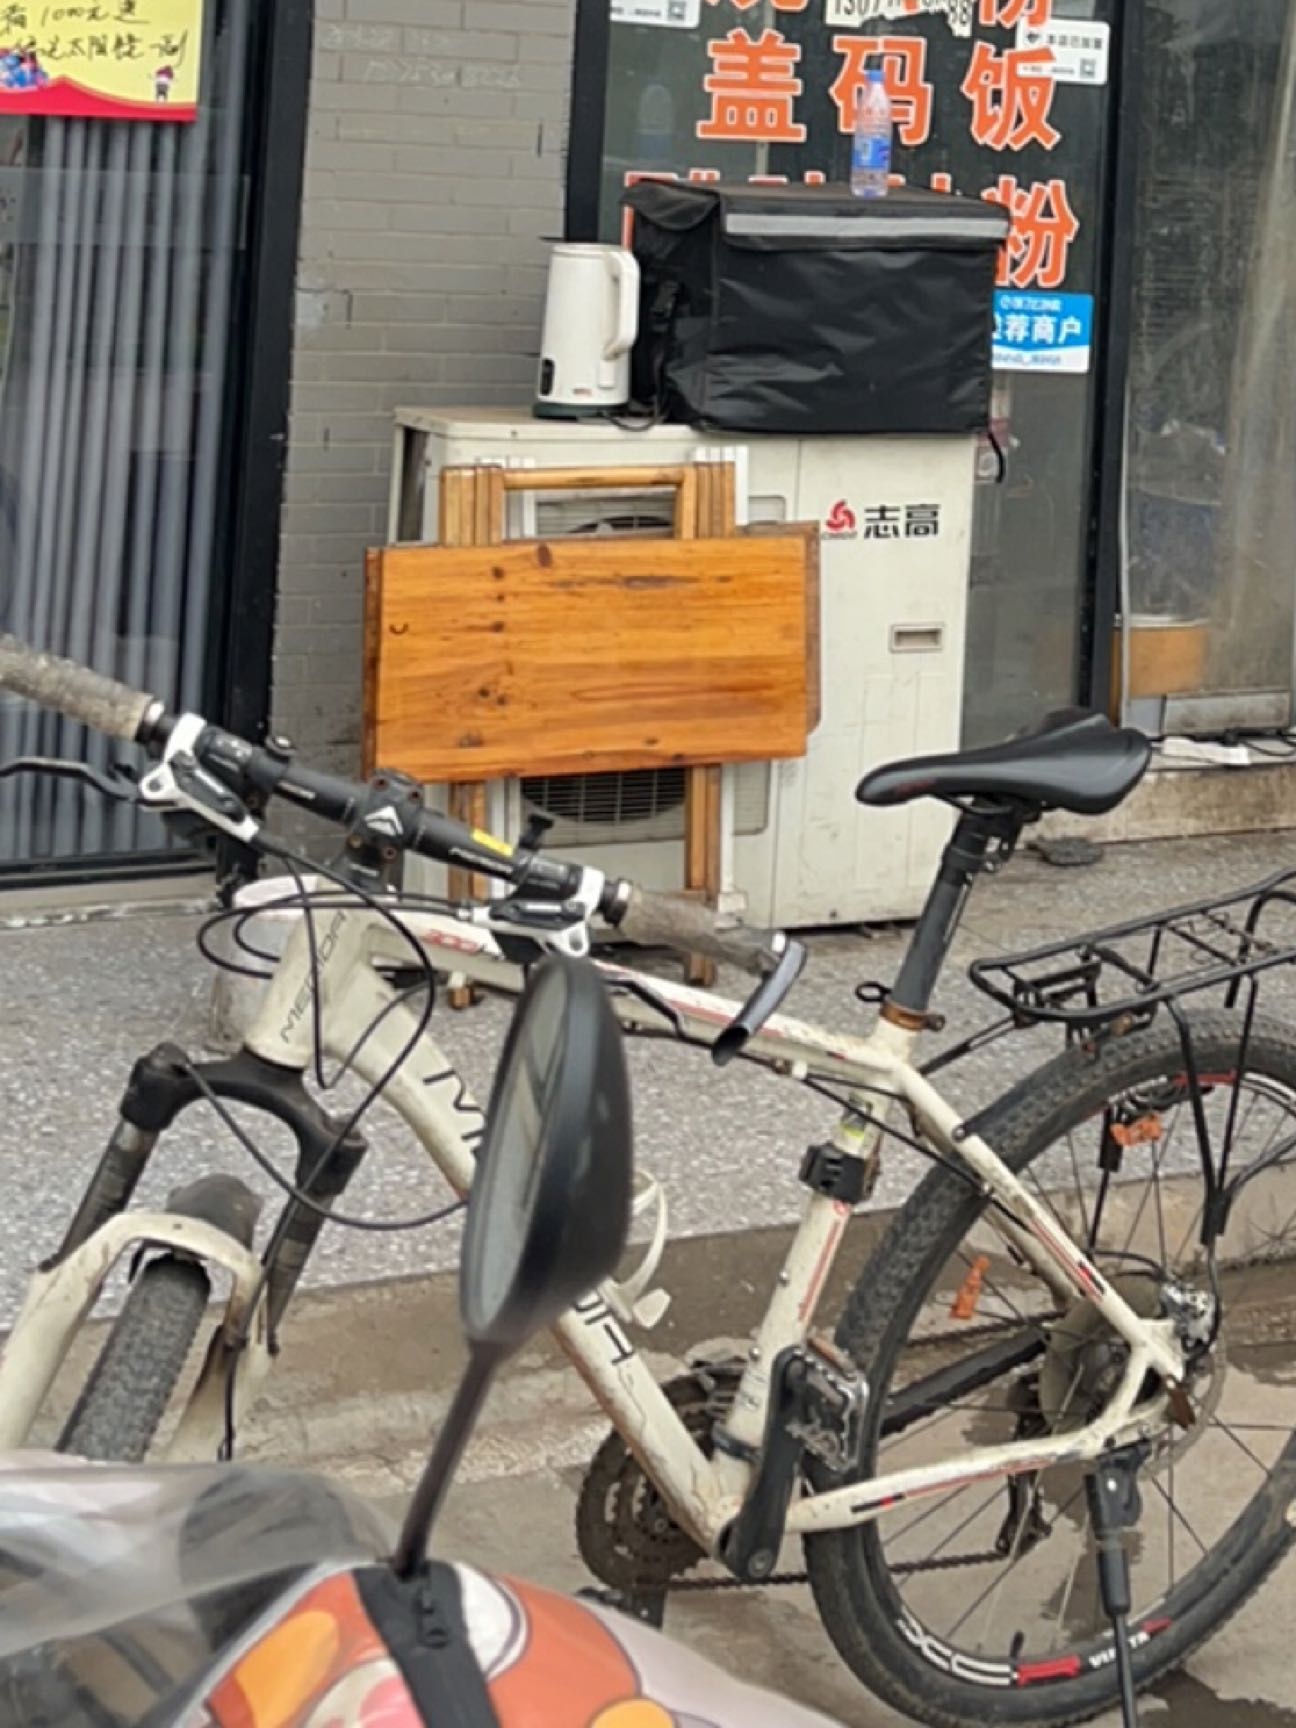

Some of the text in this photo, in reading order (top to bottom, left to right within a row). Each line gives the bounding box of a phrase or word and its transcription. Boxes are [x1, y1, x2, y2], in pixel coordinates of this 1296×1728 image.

[697, 27, 1062, 151] 盖码饭
[863, 503, 940, 540] 志高
